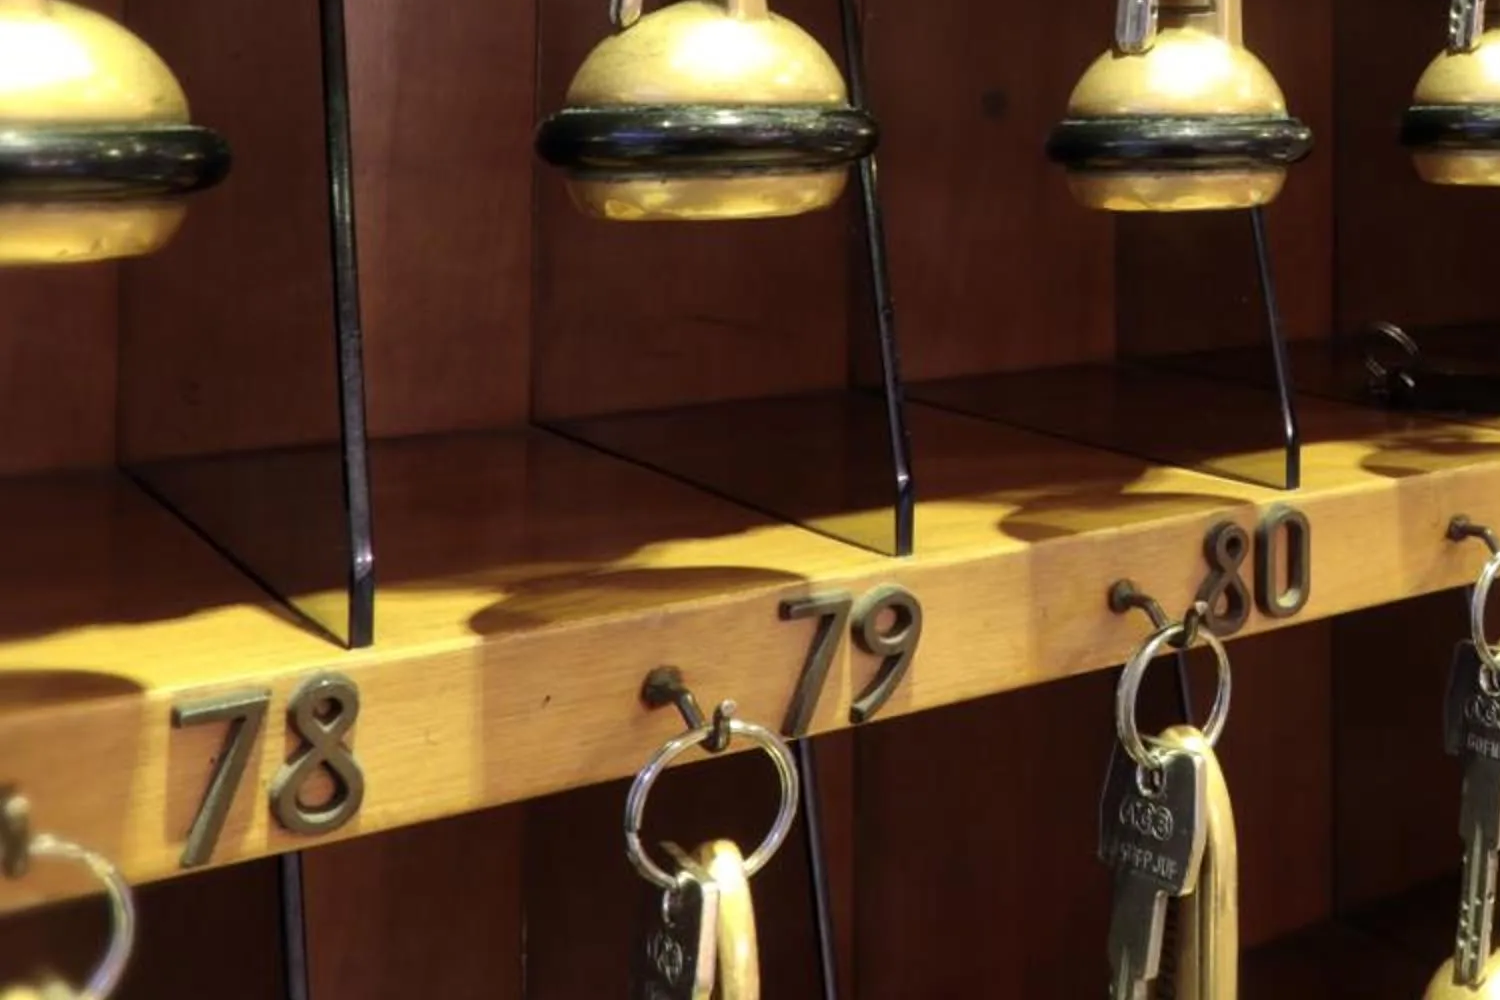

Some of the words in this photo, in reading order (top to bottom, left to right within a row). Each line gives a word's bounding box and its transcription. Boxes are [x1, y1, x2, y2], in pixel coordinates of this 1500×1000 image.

[1201, 504, 1312, 636] 80
[778, 584, 923, 739] 79
[172, 669, 366, 868] 78
